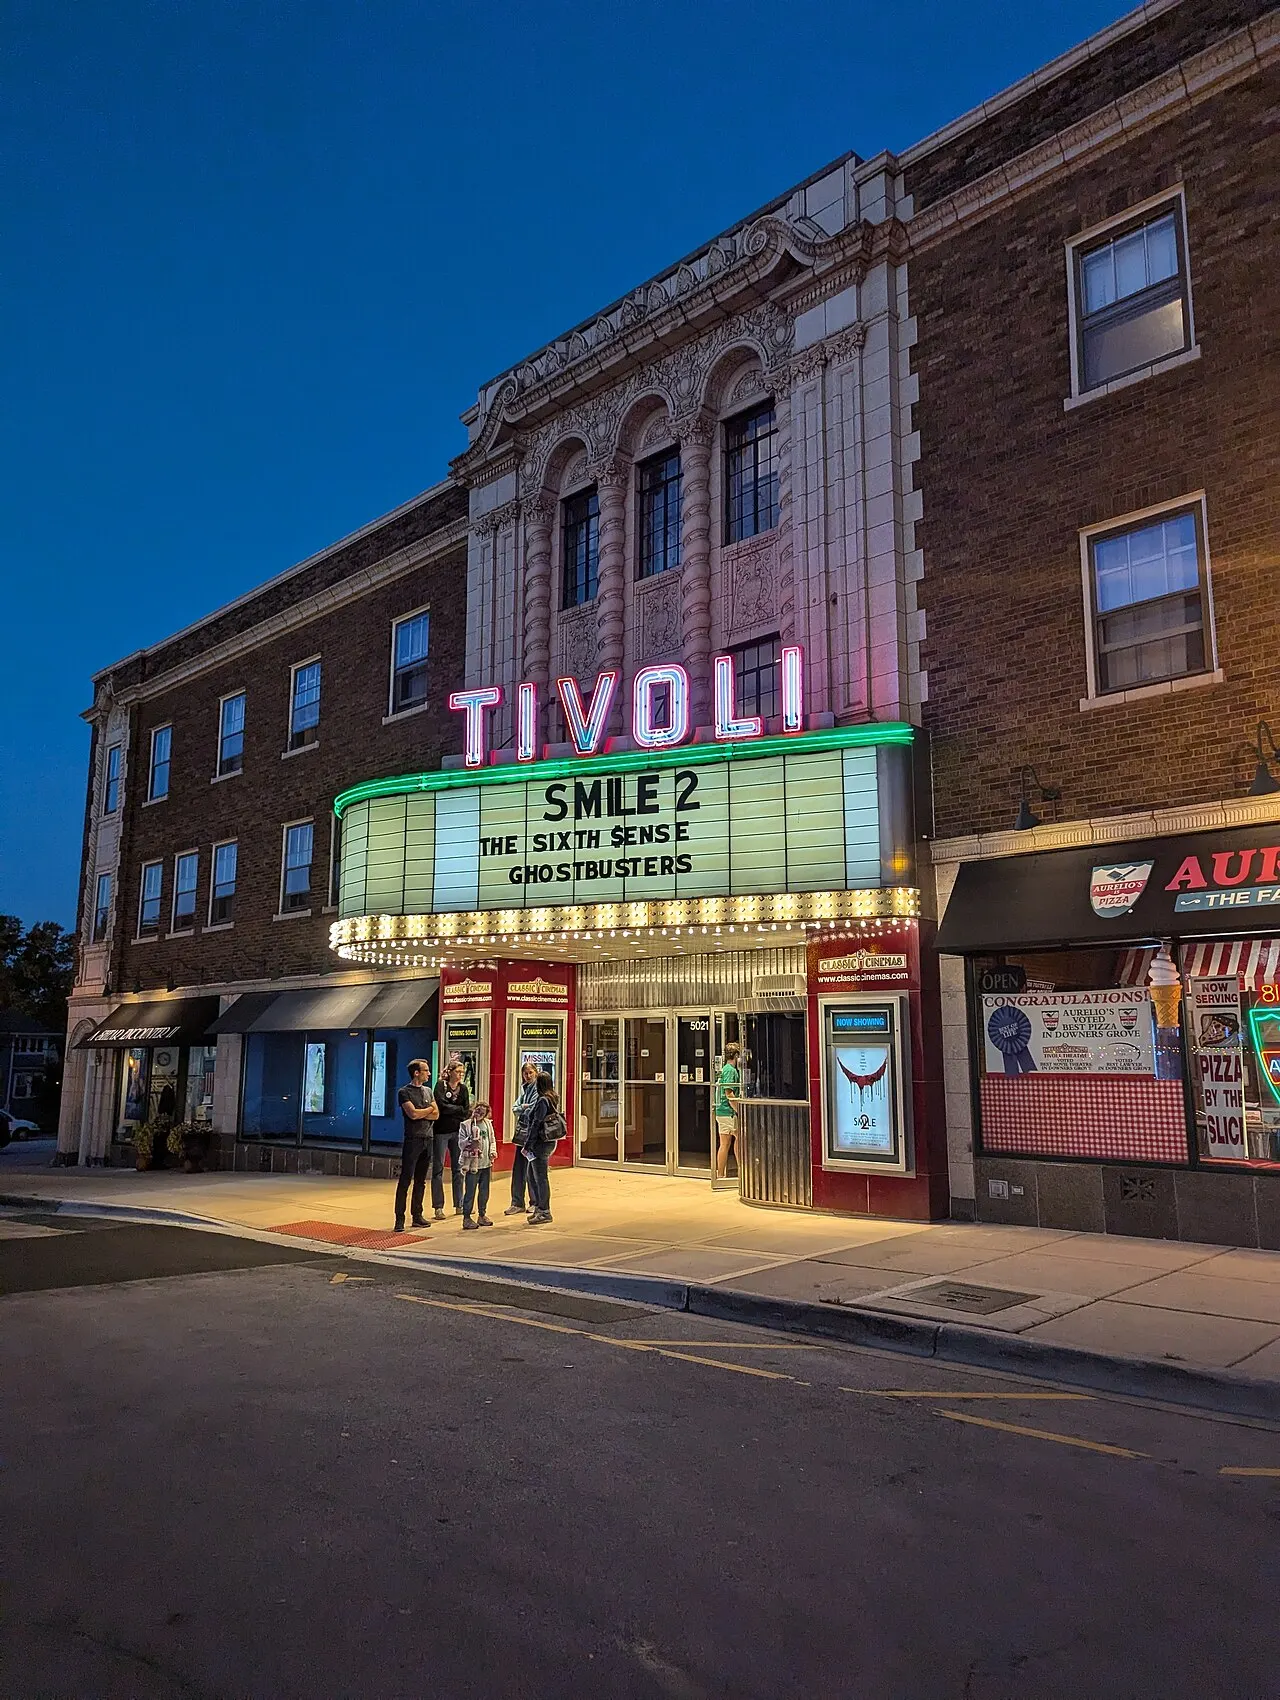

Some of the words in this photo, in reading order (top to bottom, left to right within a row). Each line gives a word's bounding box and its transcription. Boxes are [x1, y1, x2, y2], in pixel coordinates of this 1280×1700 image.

[450, 646, 803, 768] TIVOLI
[543, 774, 660, 822] SMILE
[675, 770, 700, 812] 2
[480, 835, 518, 856] THE
[533, 830, 600, 852] SIXTH
[509, 854, 693, 884] GHOSTBUSTERS
[1092, 880, 1143, 893] AURELIO'S
[1099, 896, 1129, 905] PIZZA
[1206, 891, 1250, 907] THE
[821, 958, 857, 970] CLASSIC
[865, 956, 903, 968] CINEMAS
[818, 973, 909, 983] www.classiccinemas.com
[982, 973, 1019, 989] OPEN
[445, 985, 466, 994] CLASSIC
[470, 984, 490, 993] CINEMAS
[510, 984, 536, 993] CLASSIC
[541, 985, 565, 994] CINEMAS
[1202, 983, 1228, 992] NOW
[984, 990, 1149, 1008] CONGRATULATIONS!
[1196, 993, 1238, 1004] SERVING
[1063, 1008, 1115, 1017] AURELIO'S
[690, 1021, 709, 1031] 5021
[853, 1018, 885, 1026] SHOWING
[1062, 1023, 1086, 1031] BEST
[1088, 1023, 1117, 1031] PIZZA
[523, 1054, 554, 1063] MISSING
[1200, 1054, 1242, 1082] PIZZA
[1205, 1089, 1217, 1107] BY
